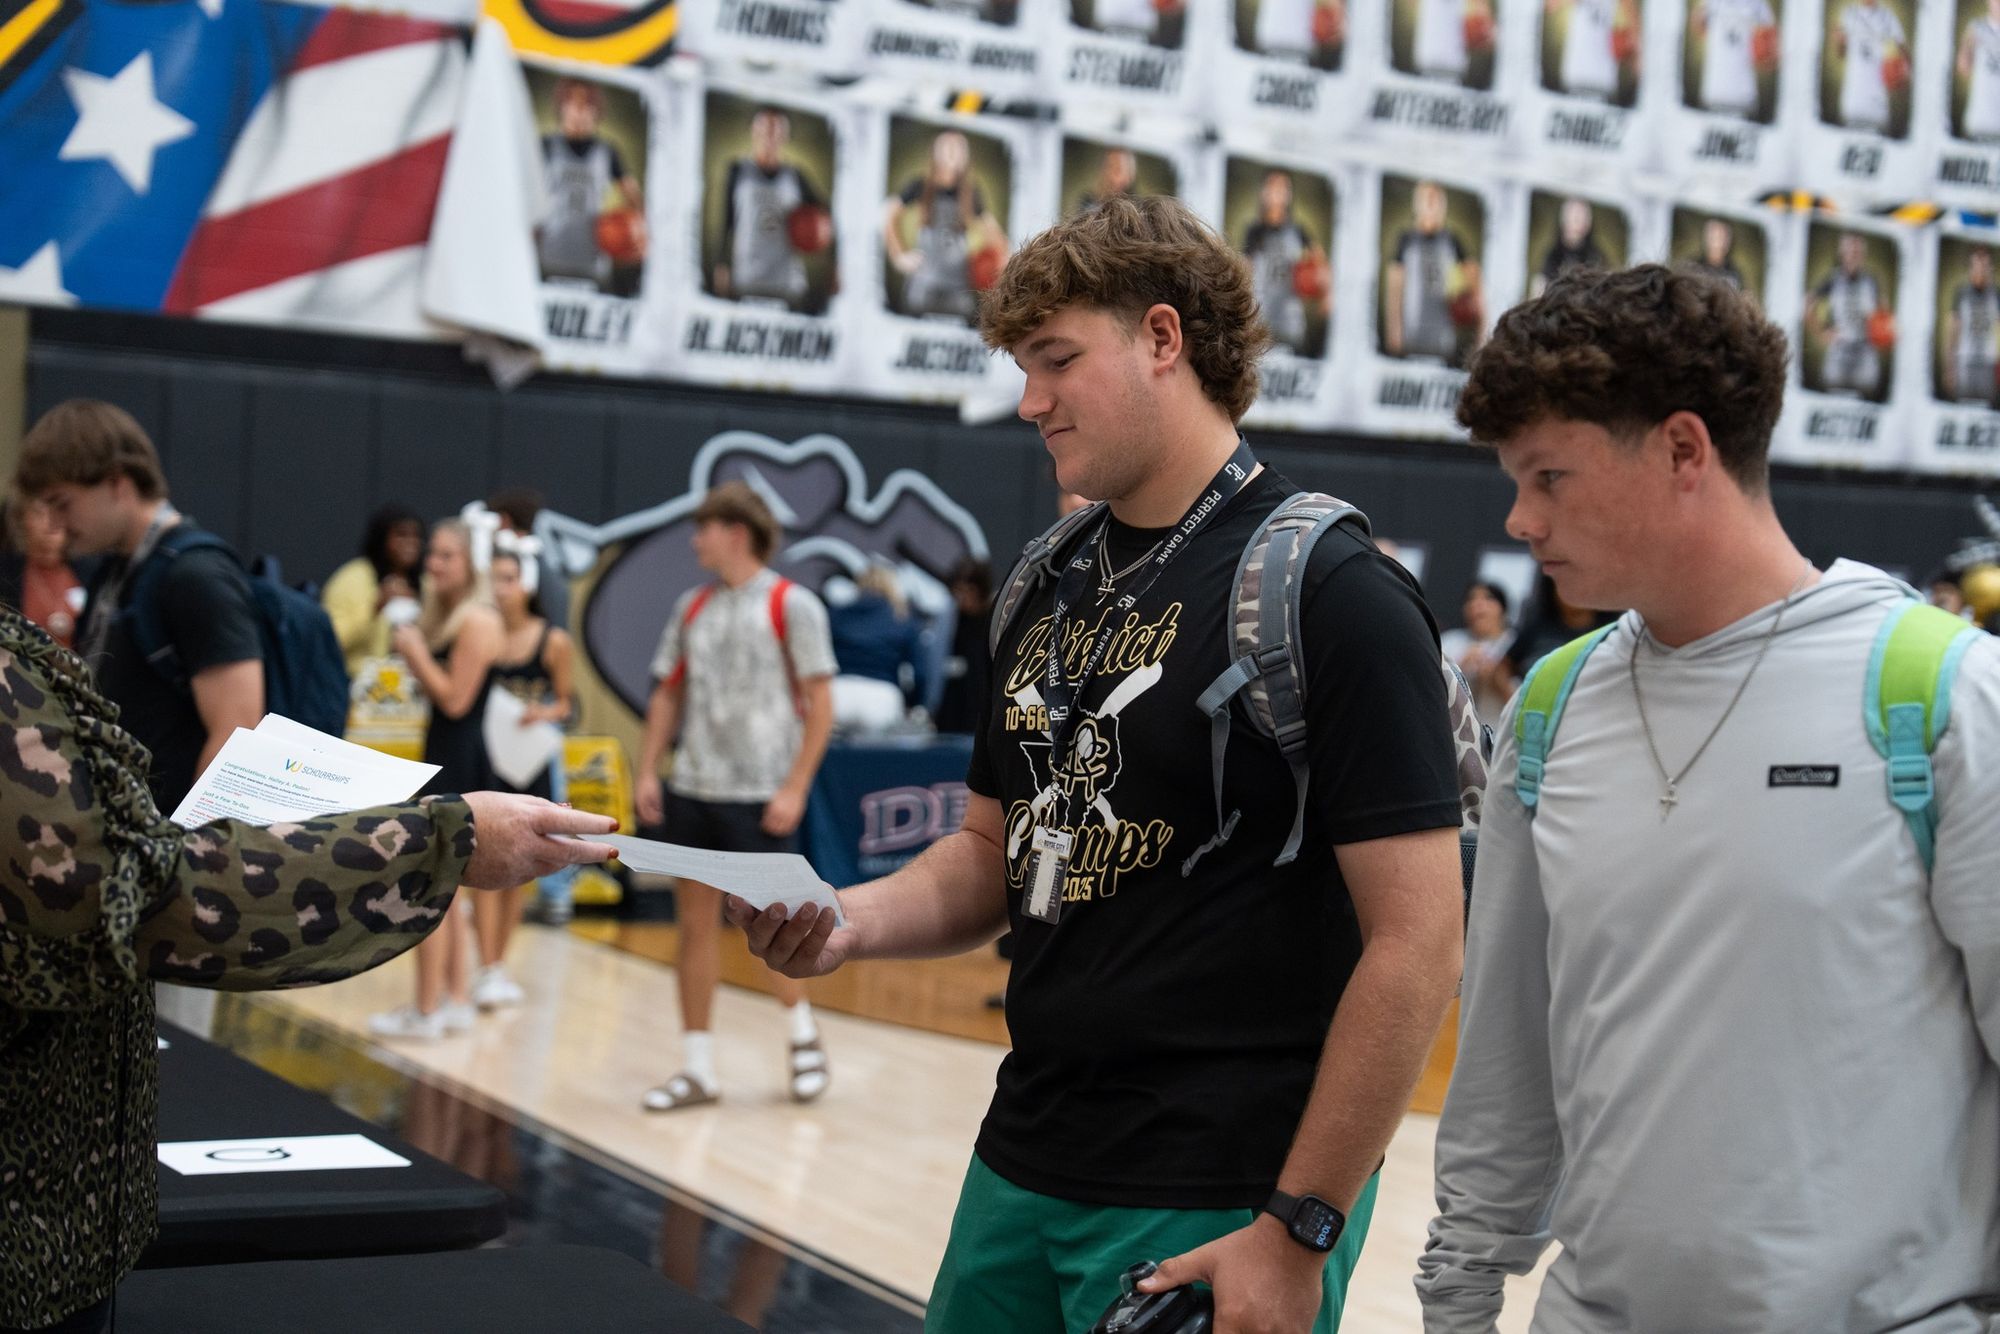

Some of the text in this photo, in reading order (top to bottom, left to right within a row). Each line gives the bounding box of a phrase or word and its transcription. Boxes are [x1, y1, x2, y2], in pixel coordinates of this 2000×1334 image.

[1155, 489, 1223, 565] PERFECT GAME
[1083, 627, 1113, 677] PERFECT
[224, 761, 267, 780] Congratulations,
[301, 766, 351, 785] SCHOLARSHIPS
[219, 795, 231, 803] Few
[1061, 877, 1095, 902] 2025
[1316, 1224, 1332, 1246] 10:09
